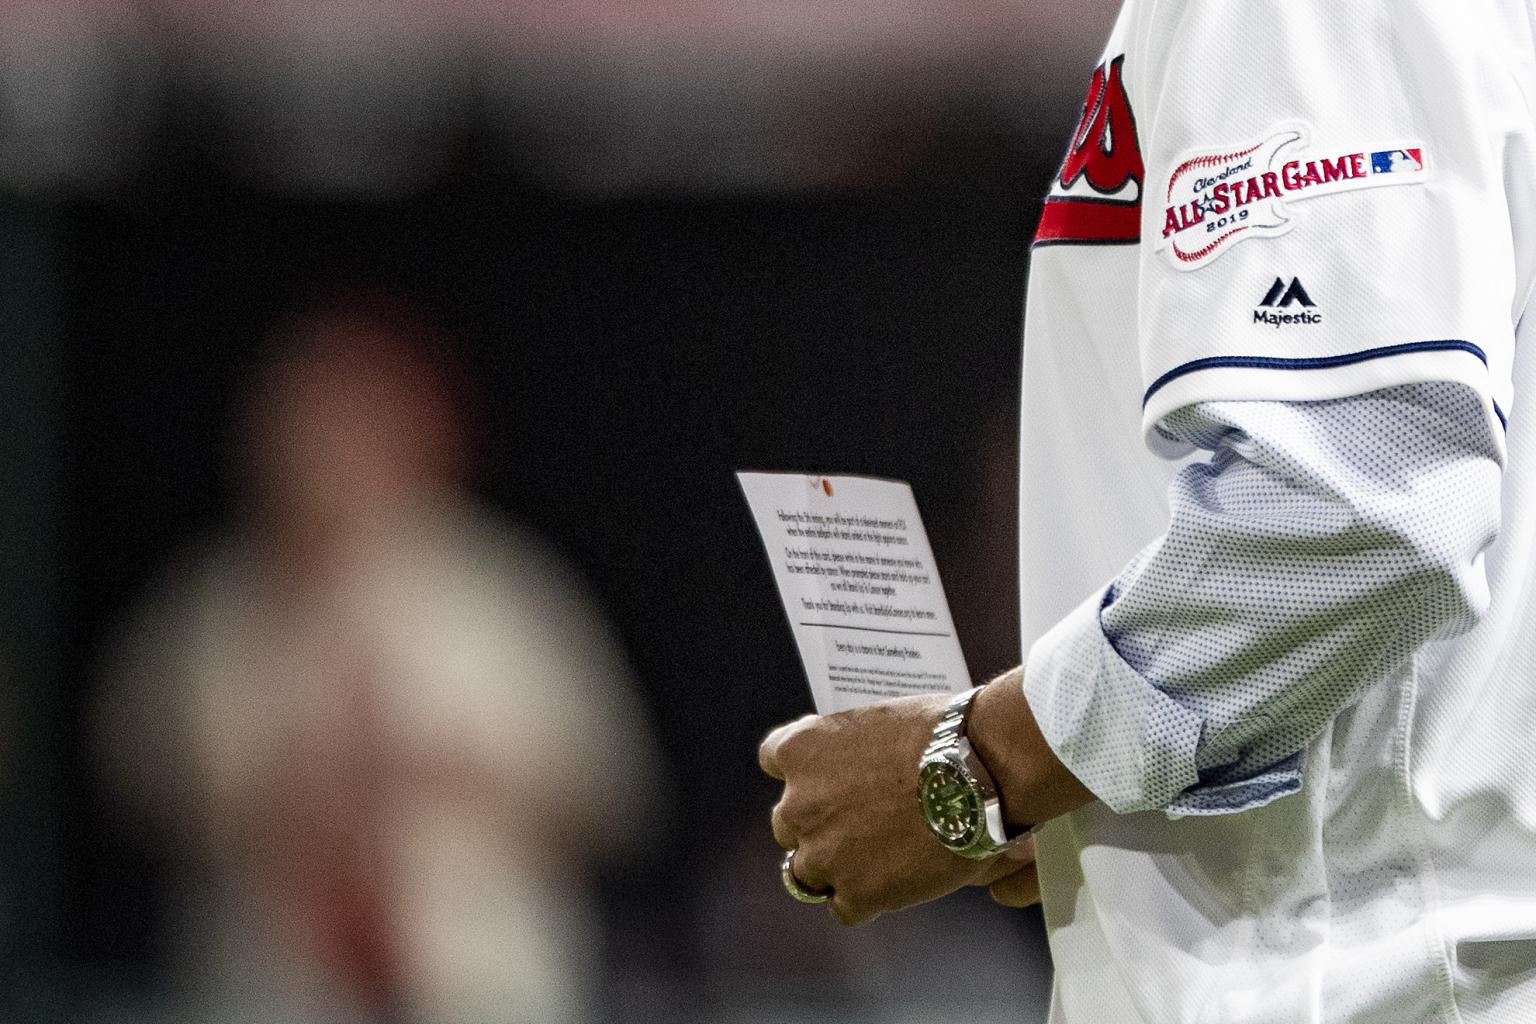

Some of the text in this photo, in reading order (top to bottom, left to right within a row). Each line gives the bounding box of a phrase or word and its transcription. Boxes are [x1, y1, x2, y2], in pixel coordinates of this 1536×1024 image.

[1193, 158, 1253, 193] Cleveland
[1281, 152, 1368, 191] GAME
[1206, 209, 1249, 233] 2019
[1253, 310, 1322, 328] Majestic
